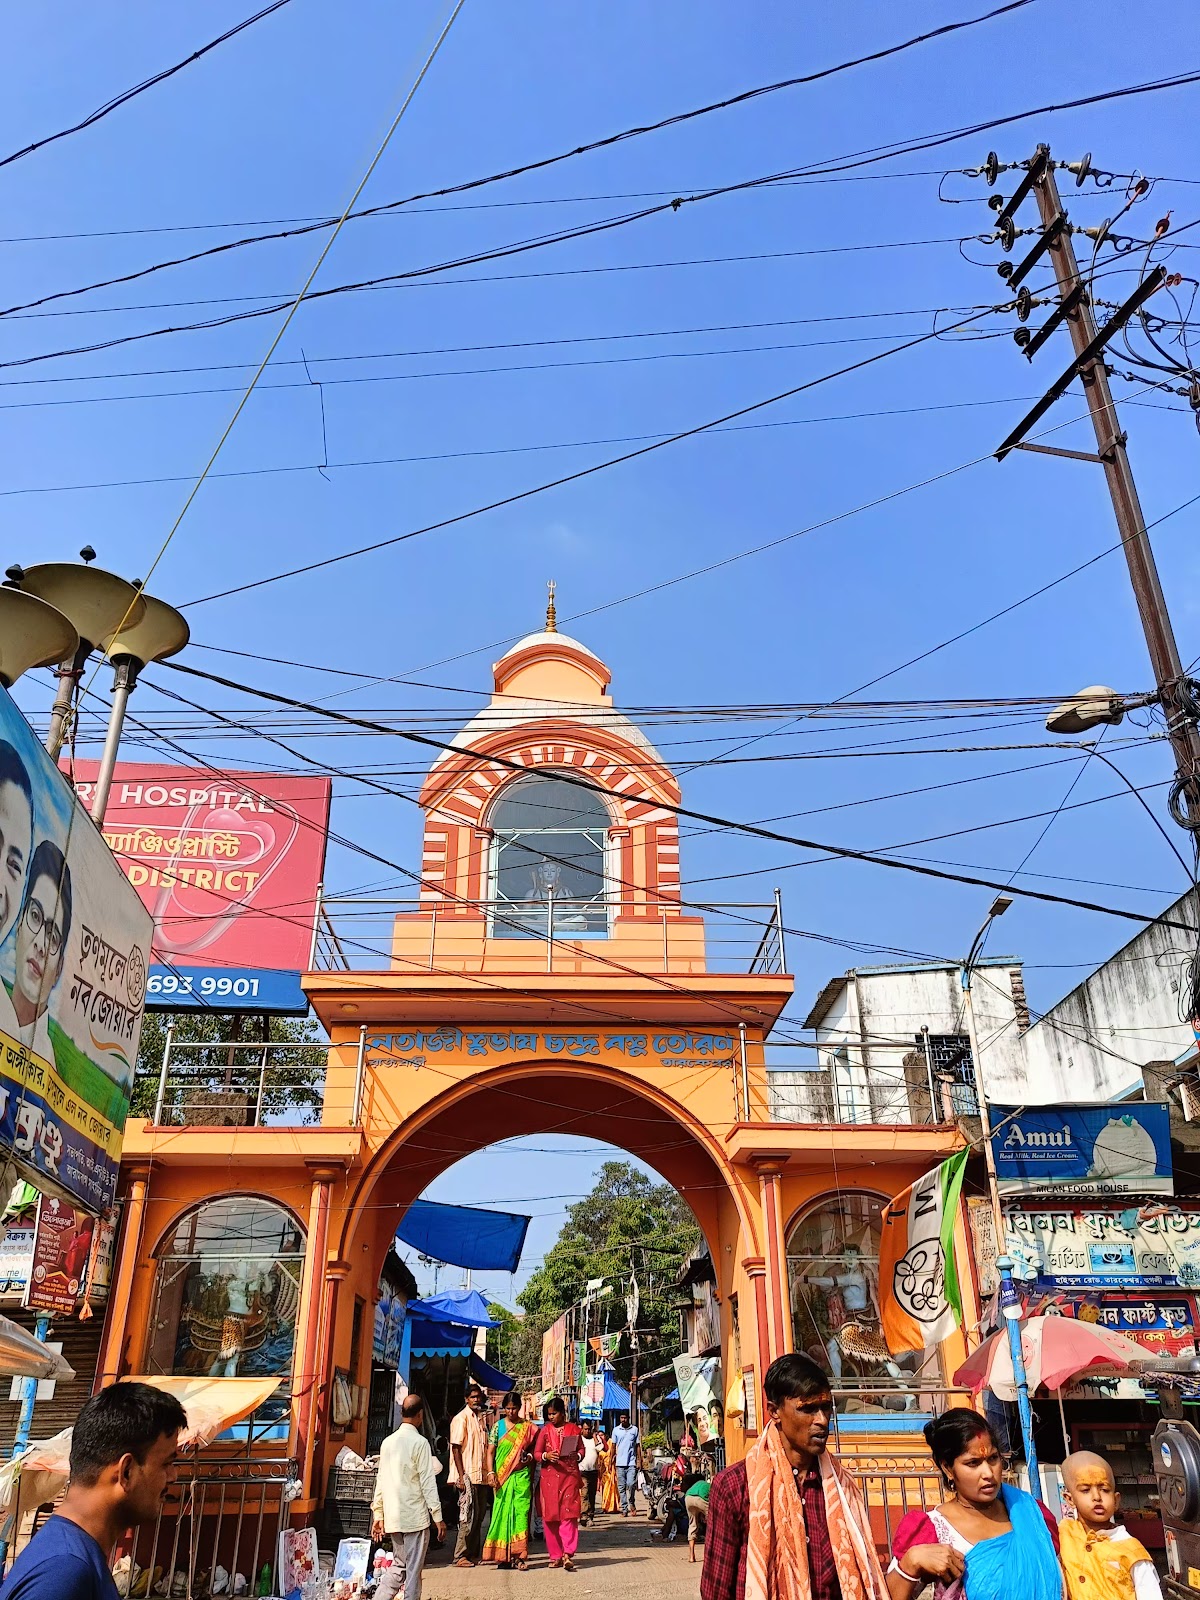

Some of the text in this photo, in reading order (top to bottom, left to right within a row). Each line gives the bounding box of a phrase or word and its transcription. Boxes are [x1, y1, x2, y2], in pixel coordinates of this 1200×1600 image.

[120, 784, 275, 813] HOSPITAL
[127, 865, 260, 892] DISTRICT
[80, 924, 127, 987] তৃণমূলে
[146, 975, 260, 997] 693 9901
[365, 1026, 736, 1057] নেতাজী সুভাষ চন্দ্র বসু তোরণ
[1003, 1123, 1073, 1149] Amul
[999, 1152, 1013, 1160] Real
[1031, 1152, 1045, 1160] Real
[1046, 1152, 1056, 1160] Ice
[1036, 1184, 1129, 1194] MILAN FOOD HOUSE
[1002, 1203, 1076, 1234] মিলন
[1121, 1301, 1156, 1325] ফাস্ট
[1158, 1306, 1187, 1328] ফুড
